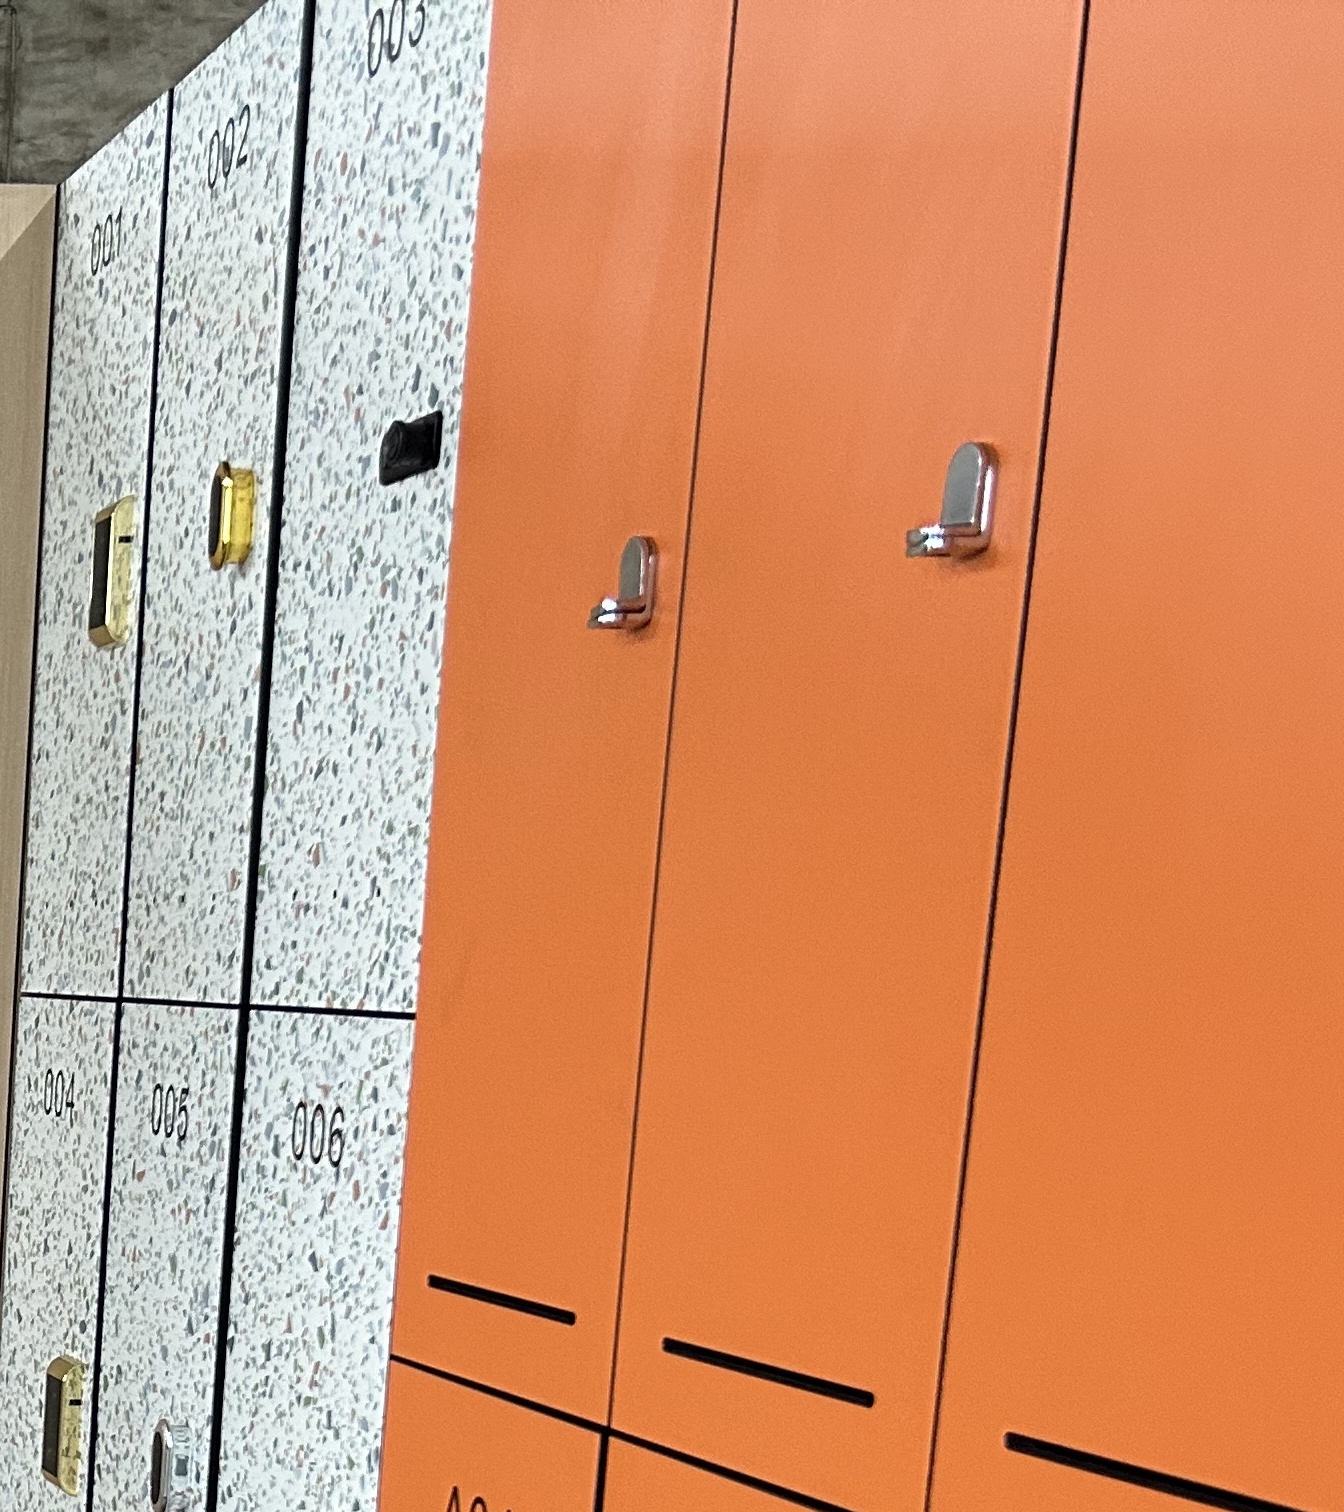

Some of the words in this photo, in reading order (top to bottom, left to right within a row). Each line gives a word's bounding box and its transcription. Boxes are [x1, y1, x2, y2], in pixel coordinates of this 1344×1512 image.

[368, 0, 425, 78] 003
[207, 104, 251, 189] 002
[91, 205, 123, 276] 001
[44, 1068, 75, 1128] 004
[150, 1083, 189, 1142] 005
[292, 1101, 345, 1168] 006
